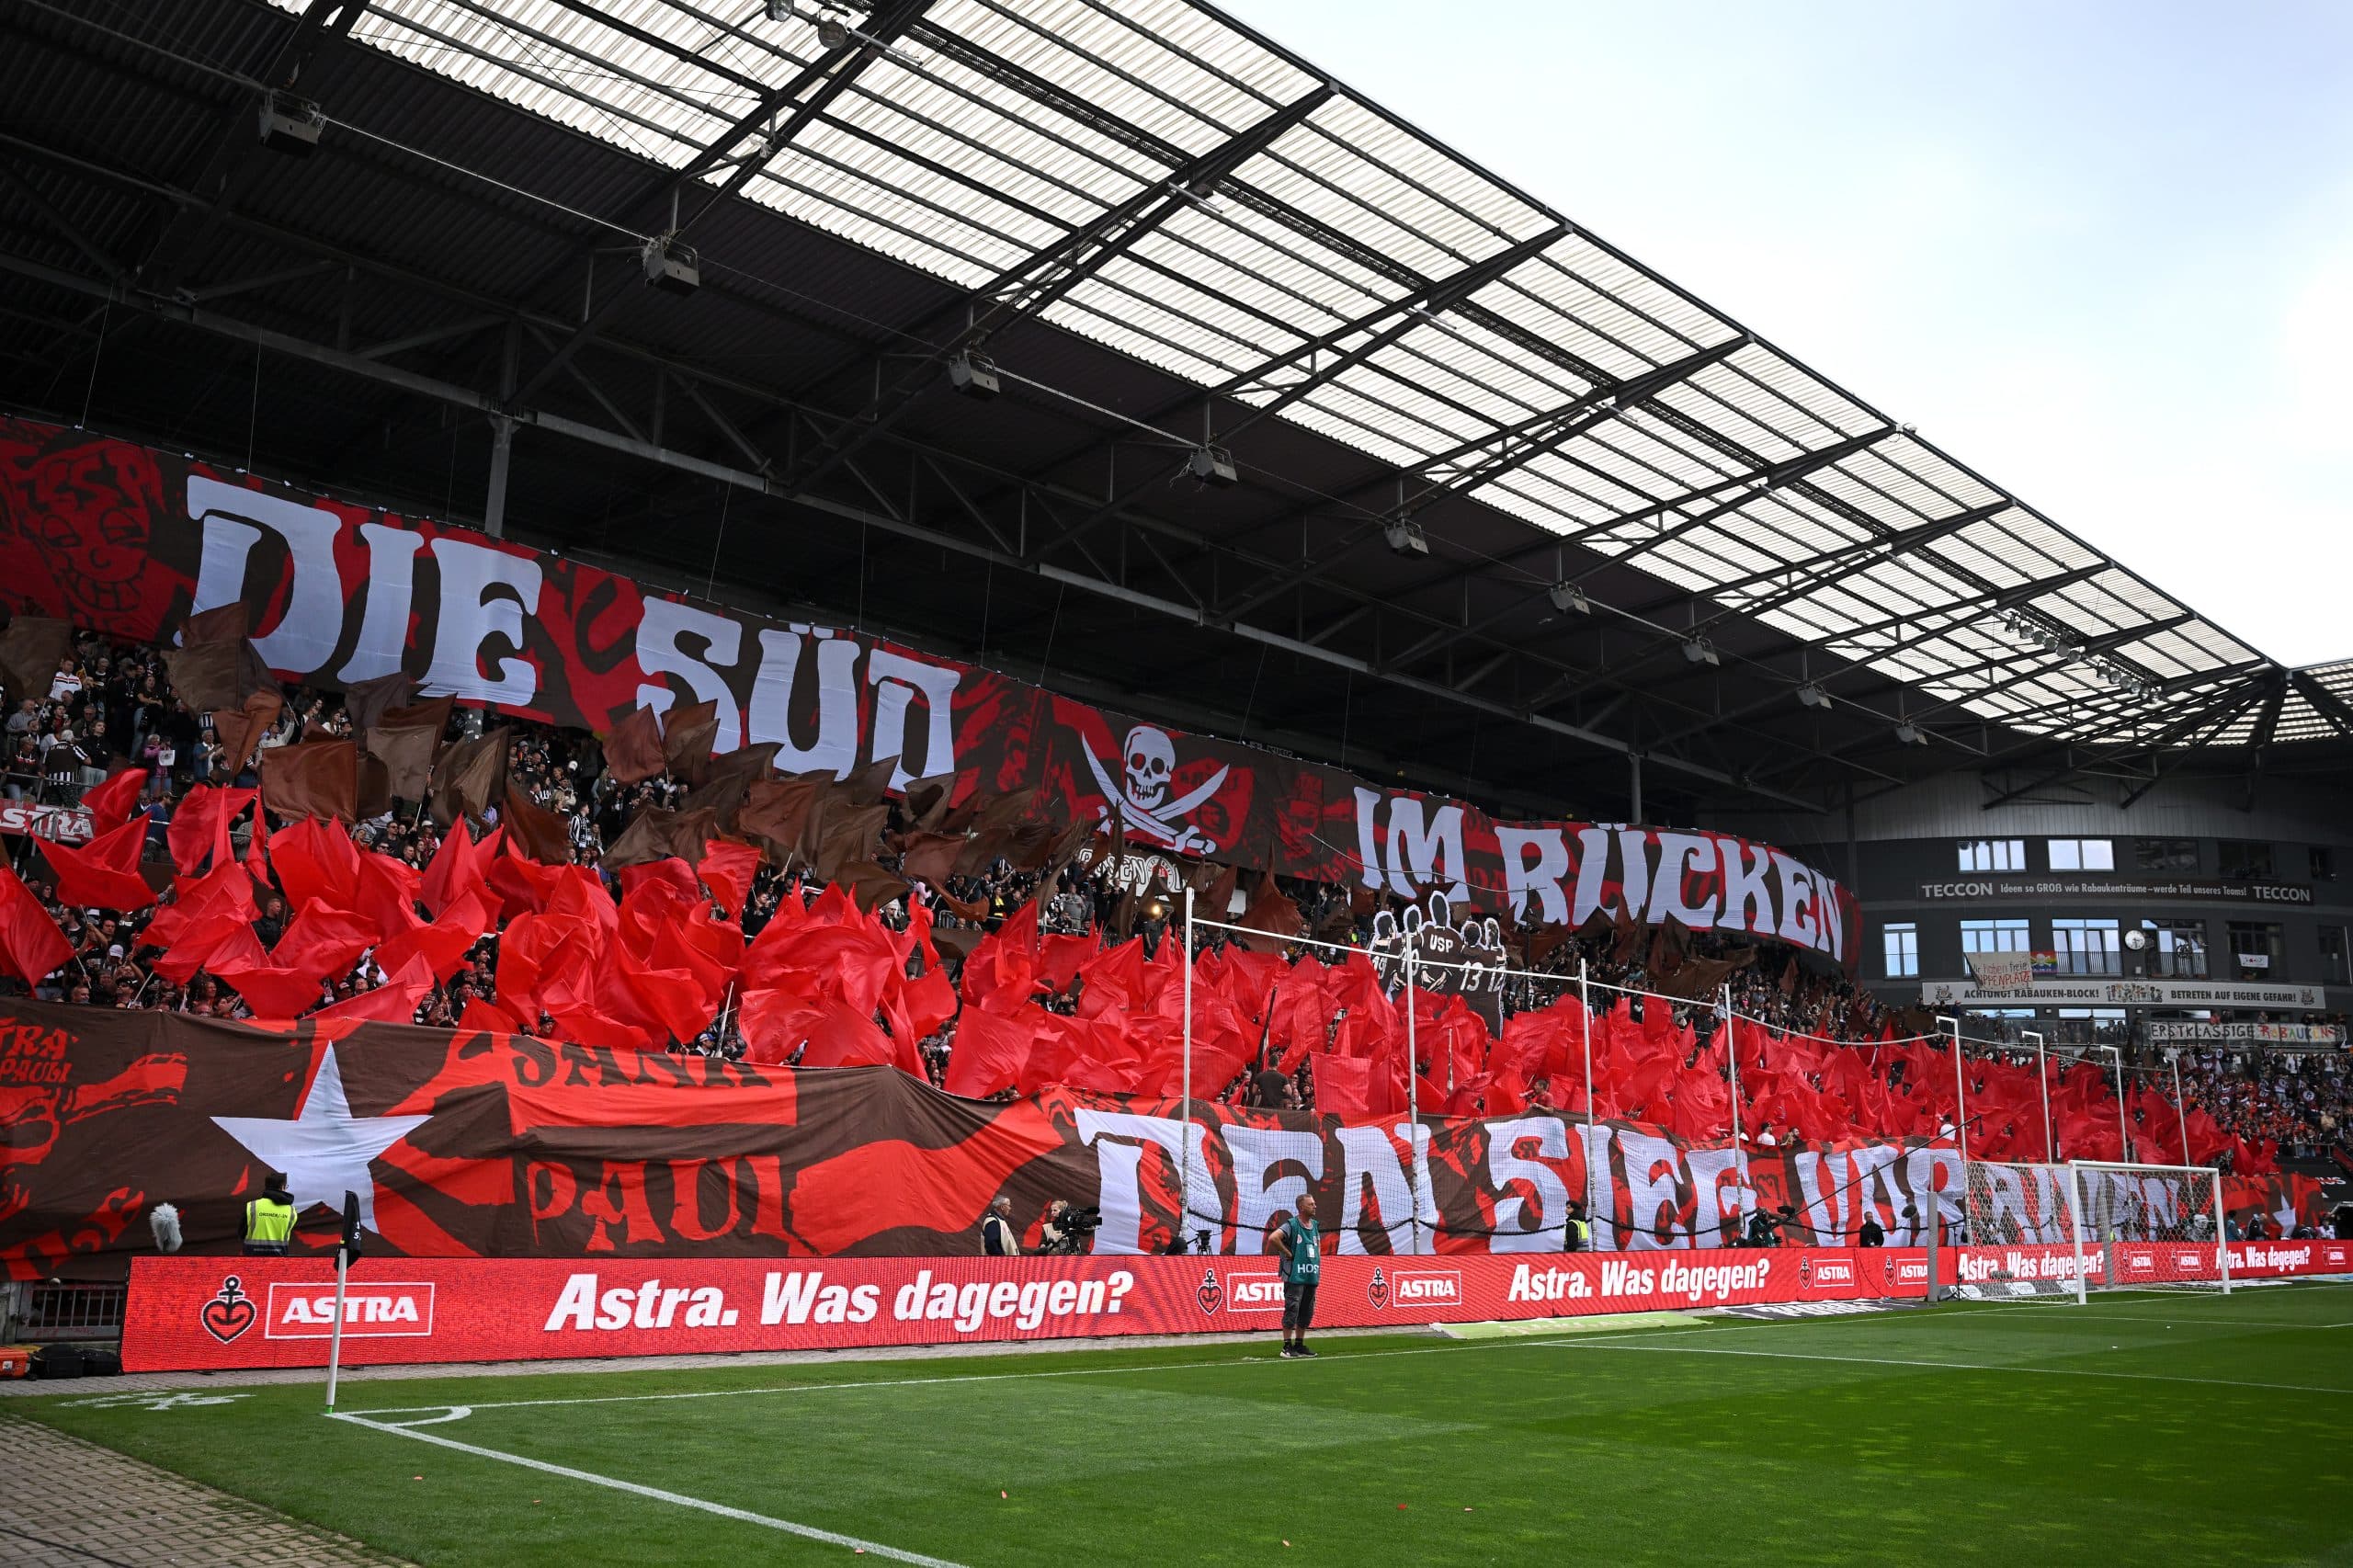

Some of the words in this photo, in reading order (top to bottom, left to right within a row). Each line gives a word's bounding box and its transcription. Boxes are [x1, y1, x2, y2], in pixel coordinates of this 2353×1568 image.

[173, 474, 543, 706] DIE
[636, 597, 961, 792] SÜD
[0, 807, 95, 838] STRA
[1354, 786, 1470, 903] IM
[1495, 823, 1843, 962] RÜCKEN
[1921, 882, 1994, 898] TECCON
[2000, 883, 2023, 893] Ideen
[2025, 885, 2034, 893] so
[2064, 884, 2079, 892] wie
[2178, 883, 2192, 894] Teil
[2193, 887, 2221, 895] unseres
[2222, 885, 2247, 896] Teams!
[2253, 886, 2311, 902] TECCON
[1429, 934, 1454, 953] USP
[1460, 960, 1483, 992] 13
[1963, 989, 2011, 999] ACHTUNG!
[2014, 989, 2099, 999] RABAUKEN-BLOCK!
[2170, 990, 2212, 1000] BETRETEN
[2215, 991, 2231, 1000] AUF
[2233, 992, 2261, 1002] EIGENE
[2263, 992, 2297, 1003] GEFAHR!
[2151, 1024, 2253, 1039] ERSTKLASSIGE
[1074, 1107, 1441, 1256] DEN
[1484, 1117, 1758, 1254] SIEG
[2006, 1252, 2038, 1278] Was
[2131, 1256, 2152, 1267] ASTRA
[2180, 1256, 2201, 1267] ASTRA
[2216, 1247, 2245, 1270] Atra.
[2245, 1246, 2267, 1267] Was
[2268, 1245, 2311, 1272] dagegen?
[1508, 1265, 1592, 1301] Astra.
[1601, 1260, 1654, 1295] Was
[1661, 1258, 1770, 1301] dagegen?
[1817, 1266, 1850, 1279] ASTRA
[1900, 1265, 1928, 1278] ASTRA
[1234, 1282, 1285, 1301] ASTR
[1400, 1279, 1455, 1297] ASTRA
[281, 1297, 418, 1324] ASTRA
[544, 1273, 738, 1331] Astra.
[760, 1271, 879, 1325] Was
[894, 1270, 1133, 1333] dagegen?
